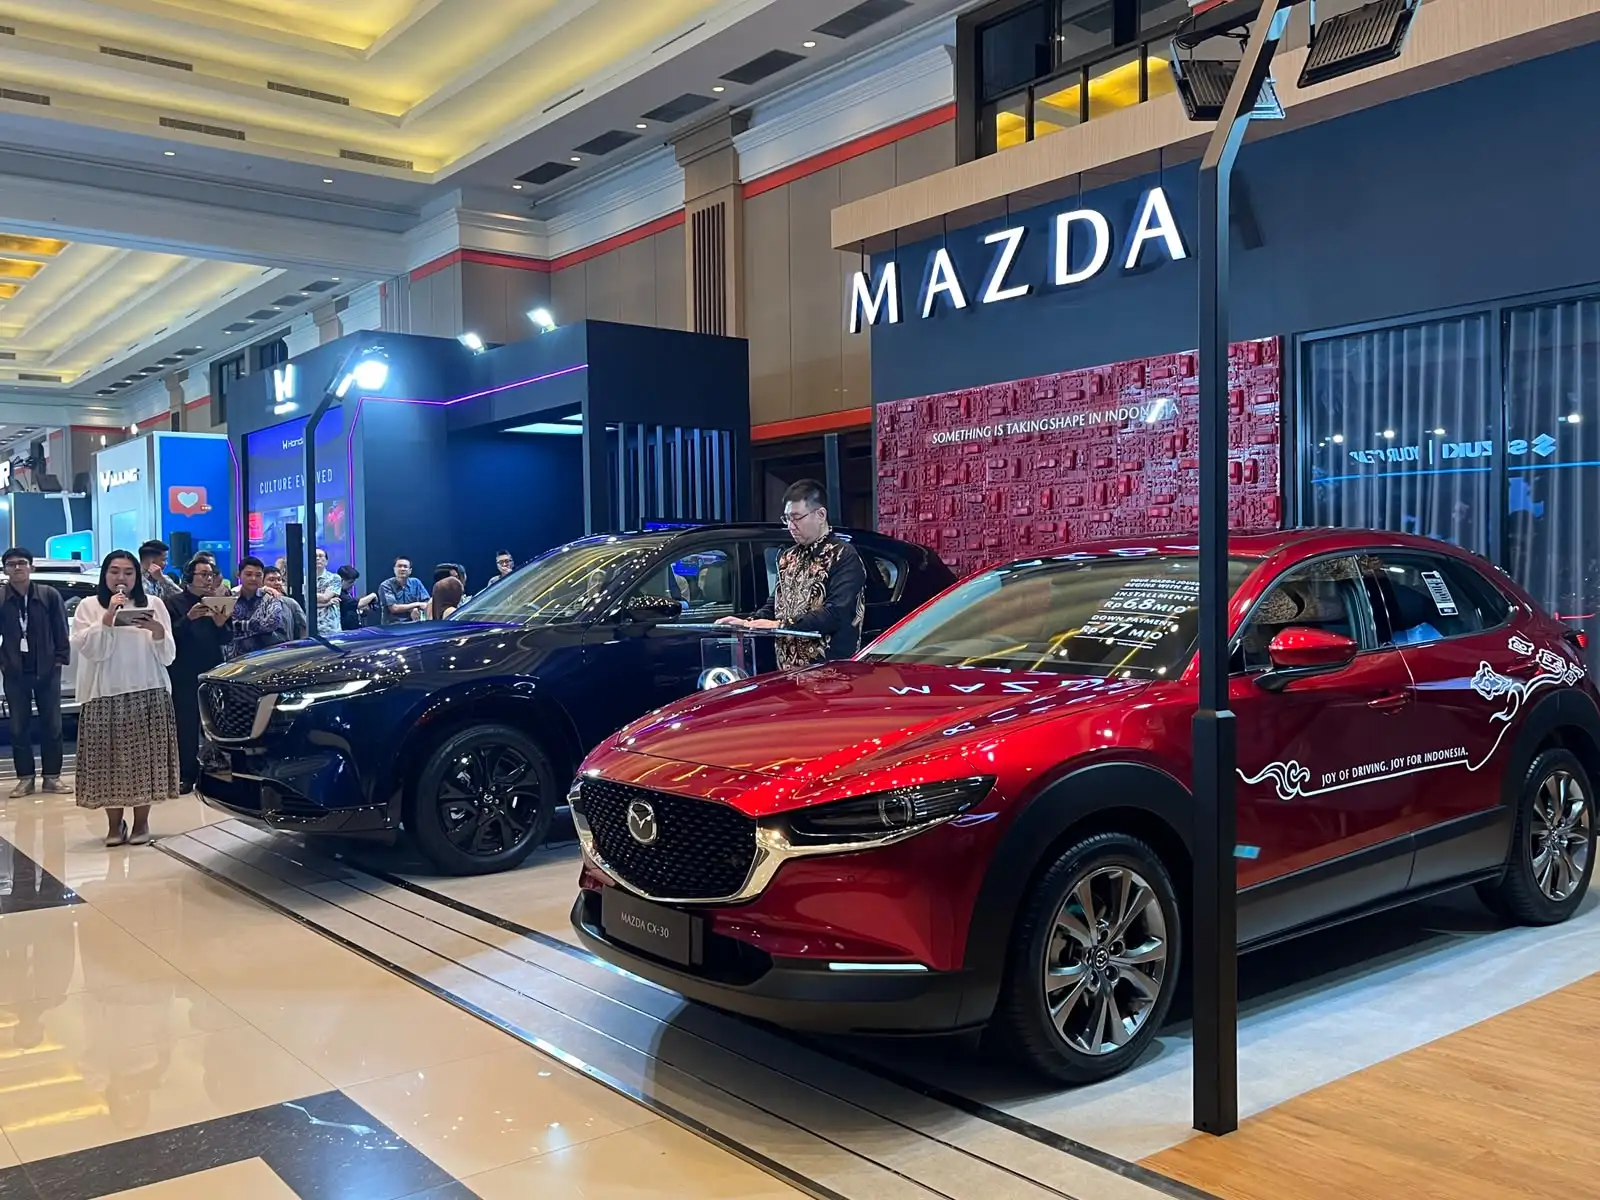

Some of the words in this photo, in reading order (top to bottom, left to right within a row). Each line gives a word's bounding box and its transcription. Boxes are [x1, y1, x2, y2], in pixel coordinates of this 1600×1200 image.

[850, 187, 1180, 334] MAZDA
[932, 426, 991, 444] SOMETHING
[994, 424, 1004, 436] IS
[1088, 411, 1101, 424] IN
[1105, 401, 1180, 422] INDONIA
[260, 476, 292, 494] CULTURE
[296, 468, 333, 488] EVVED
[1114, 591, 1197, 602] INSTALLMENTS
[1091, 614, 1124, 622] DOWN
[1125, 616, 1174, 627] PAYMENT
[1098, 622, 1133, 635] 77
[1321, 772, 1337, 787] JOY
[1338, 769, 1350, 781] OF
[1352, 761, 1389, 778] DRIVING.
[1390, 758, 1405, 771] JOY
[1406, 754, 1422, 766] FOR
[1424, 746, 1469, 763] INDONESIA.
[620, 911, 646, 931] MAZDA
[647, 922, 670, 938] CX-30
